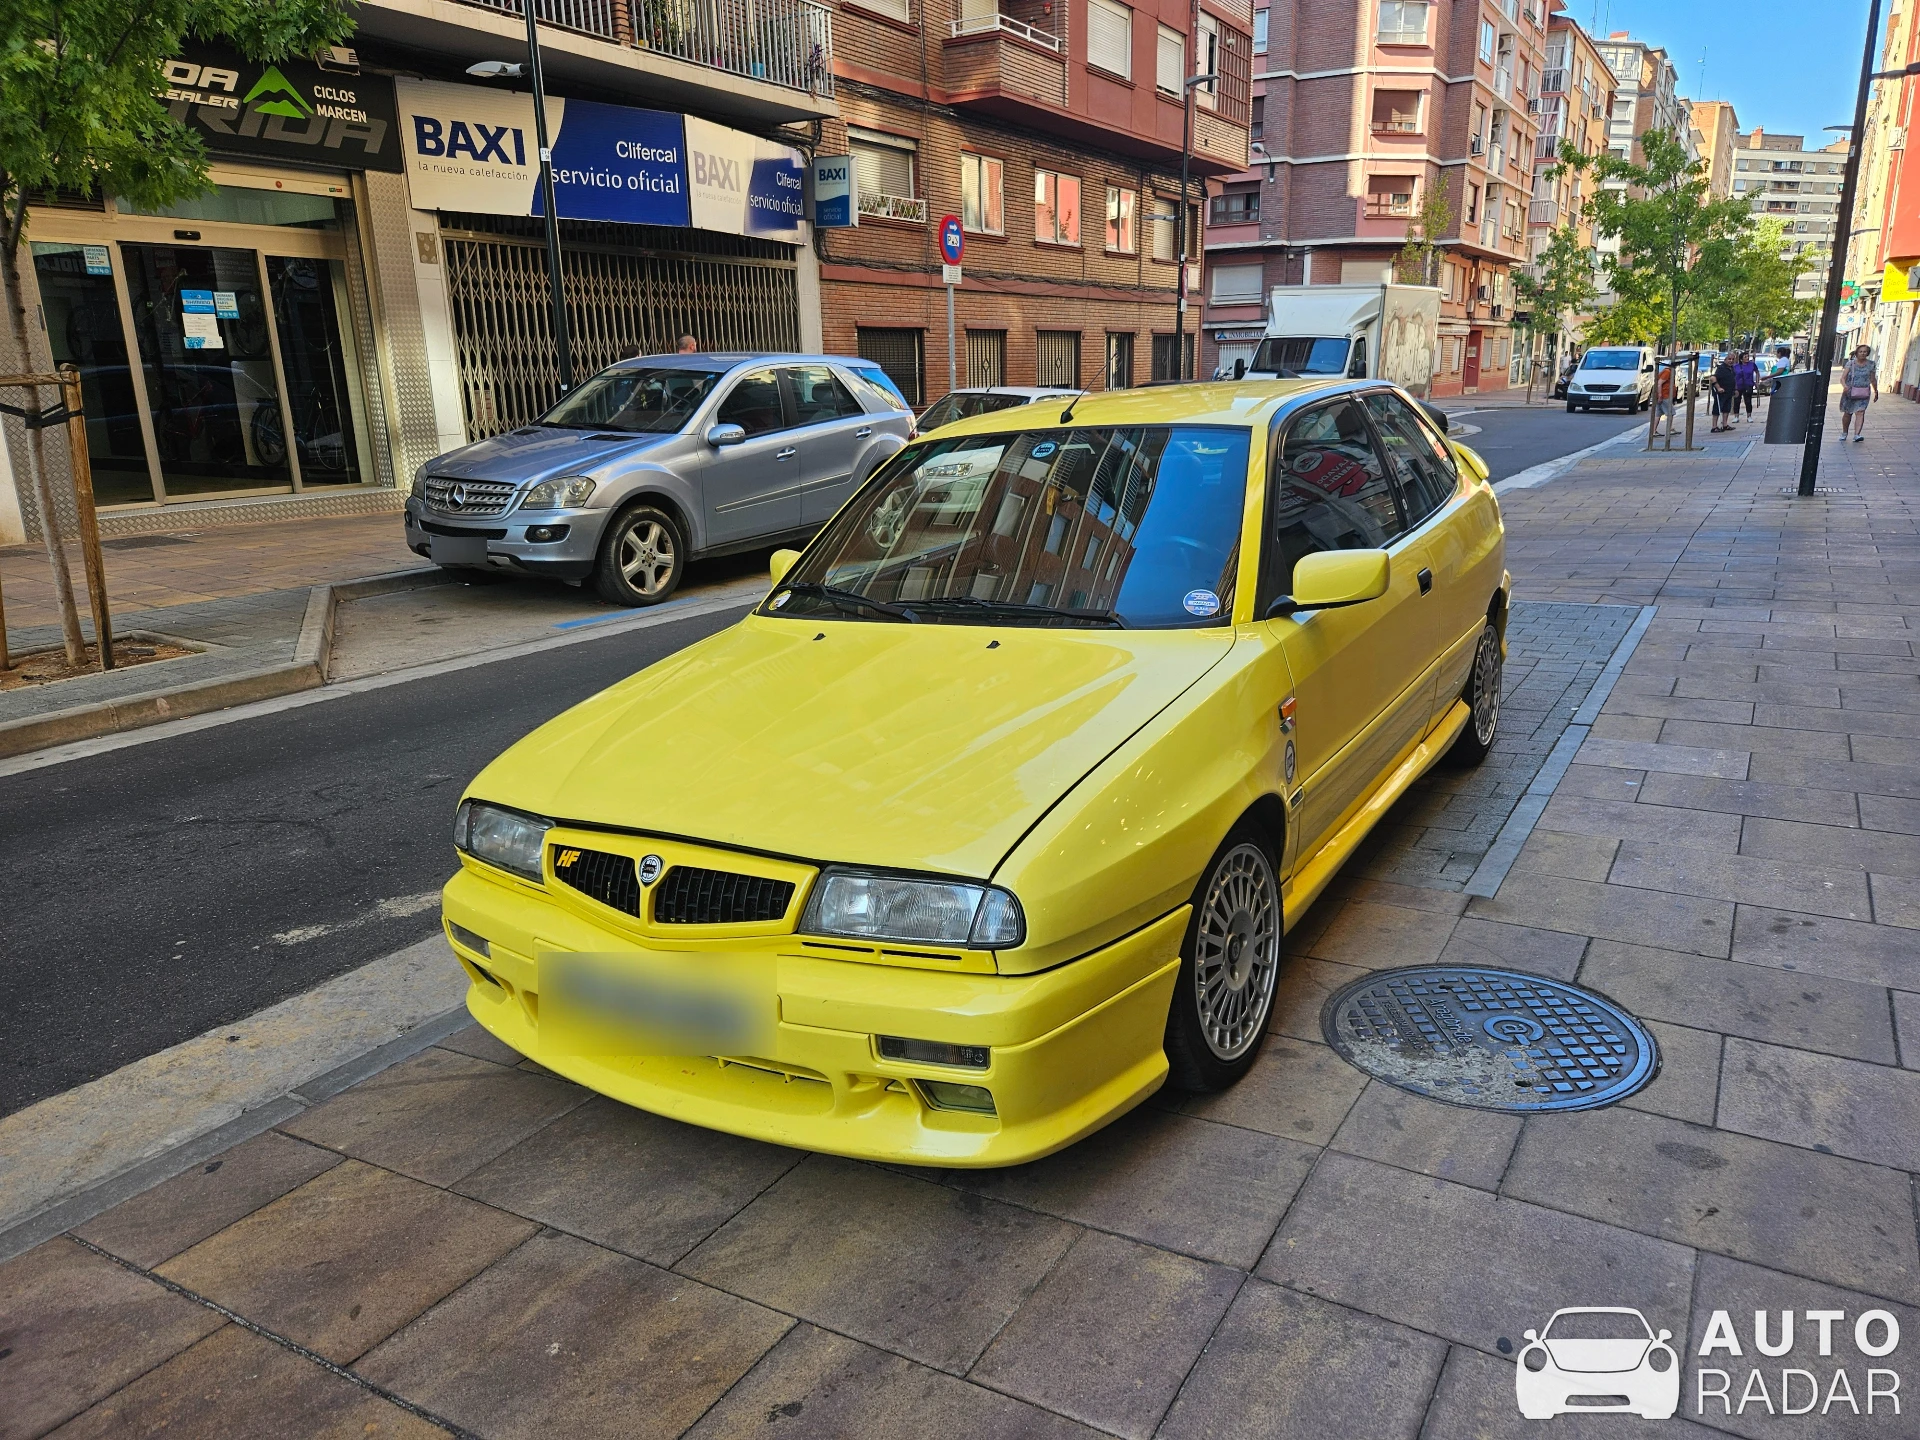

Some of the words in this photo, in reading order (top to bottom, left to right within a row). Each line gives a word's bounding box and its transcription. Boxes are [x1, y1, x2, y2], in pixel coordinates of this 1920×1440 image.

[313, 85, 357, 104] CICLOS
[316, 104, 368, 123] MARCEN
[411, 115, 526, 166] BAXI
[616, 140, 677, 163] Clifercal
[418, 161, 429, 171] la
[433, 163, 466, 175] nueva
[469, 167, 529, 182] calefacción
[551, 166, 622, 189] servicio
[627, 169, 680, 194] oficial
[693, 150, 741, 193] BAXI
[776, 171, 802, 190] Clifercal
[818, 167, 846, 181] BAXI
[750, 193, 780, 211] servicio
[781, 196, 804, 216] oficial
[1229, 331, 1265, 339] INMOBILIAR
[556, 849, 582, 867] HF
